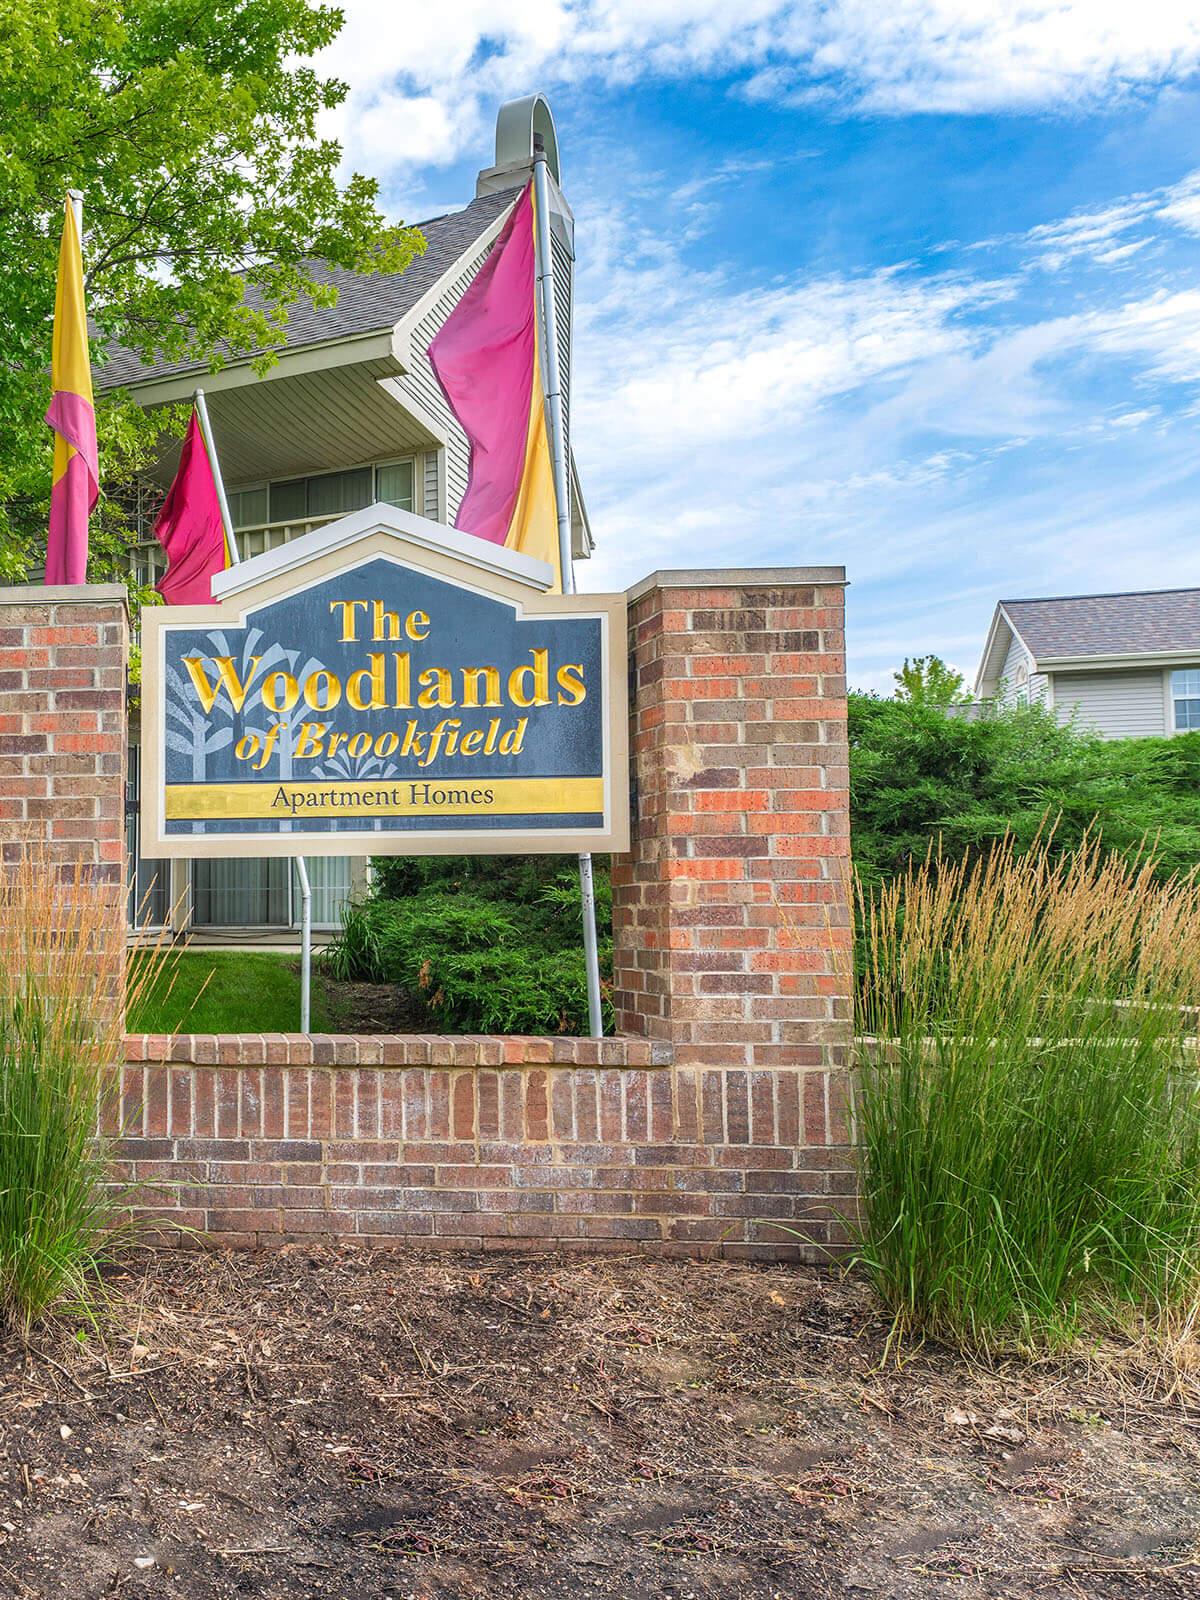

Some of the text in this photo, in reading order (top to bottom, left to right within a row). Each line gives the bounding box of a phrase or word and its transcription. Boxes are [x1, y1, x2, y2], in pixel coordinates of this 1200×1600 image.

[329, 600, 431, 642] The
[181, 648, 587, 714] Woodlands
[234, 716, 530, 770] of Brookfield
[271, 783, 494, 813] Apartment Homes
